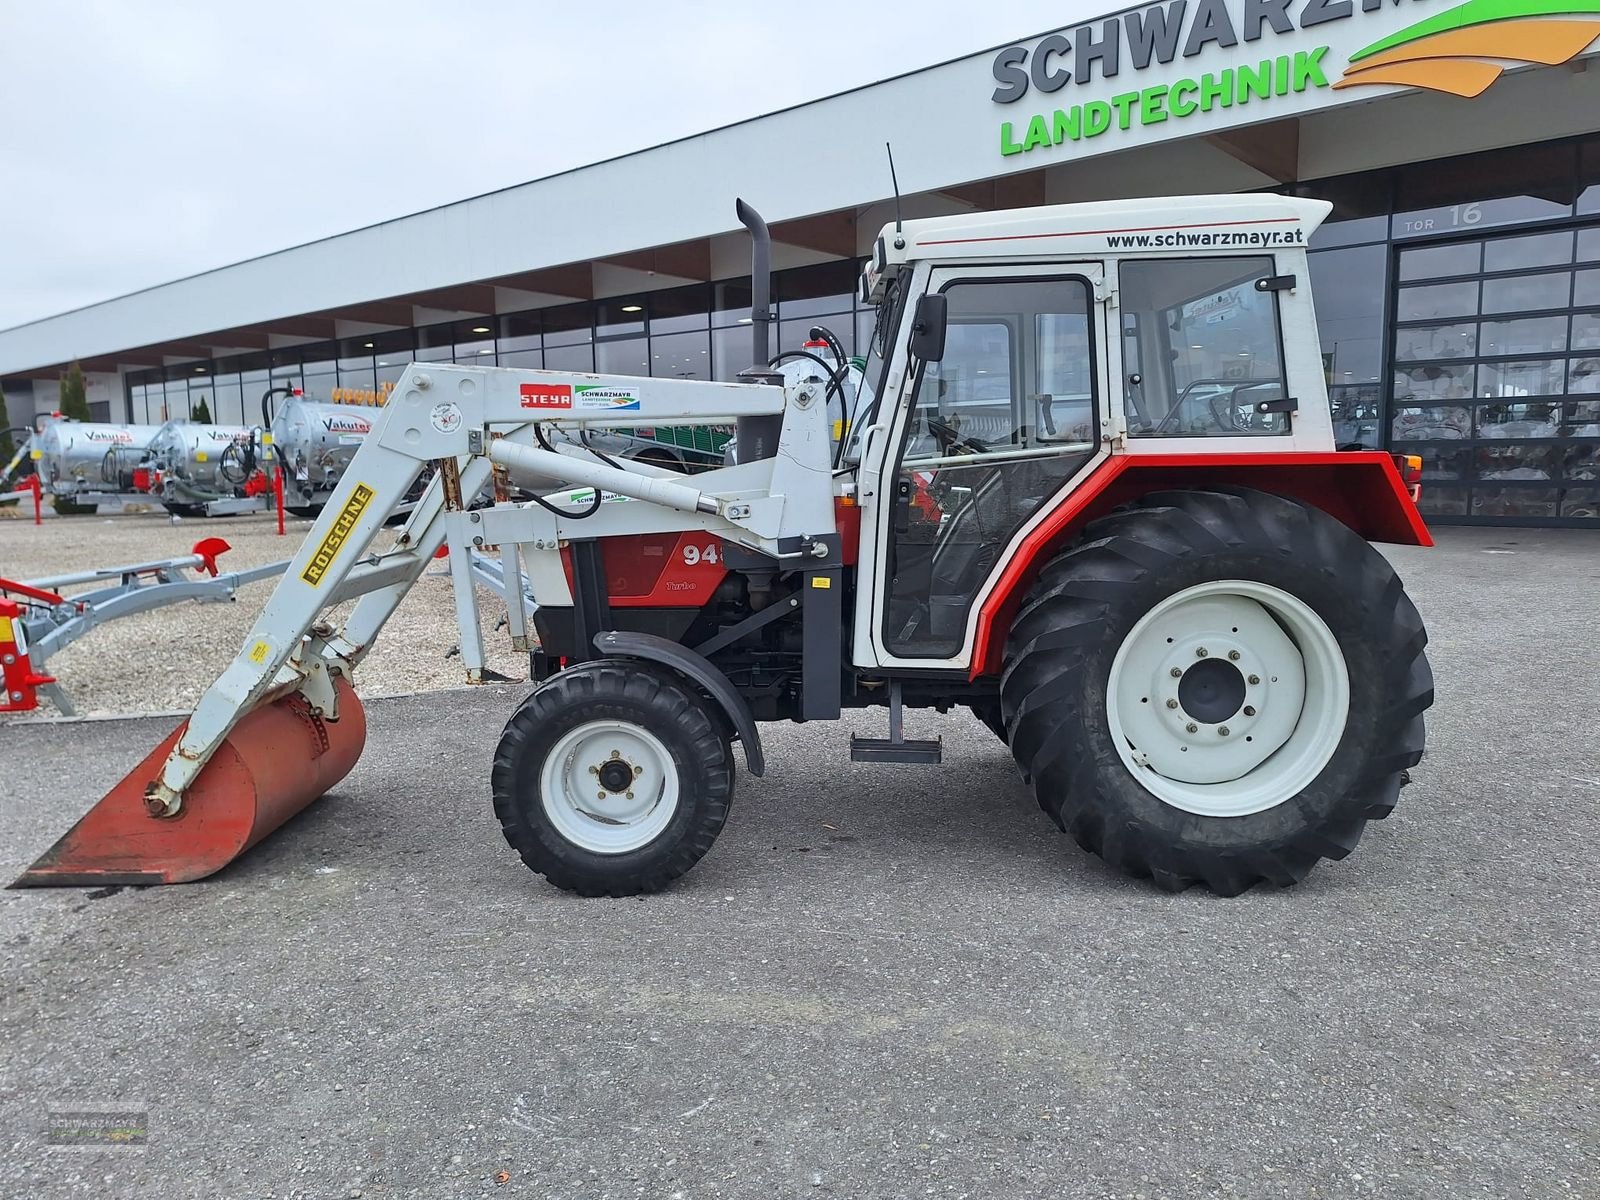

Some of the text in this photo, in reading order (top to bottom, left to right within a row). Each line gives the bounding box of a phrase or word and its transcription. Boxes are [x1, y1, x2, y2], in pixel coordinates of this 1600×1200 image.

[992, 0, 1430, 103] SCHWARZ
[1001, 46, 1330, 156] LANDTECHNIK
[1405, 203, 1482, 232] TOR 16
[1106, 229, 1303, 248] www.schwarzmayr.at
[520, 394, 570, 405] STEYR
[307, 489, 370, 580] ROTSCHNE
[683, 543, 723, 566] 94
[666, 581, 696, 591] Turbo
